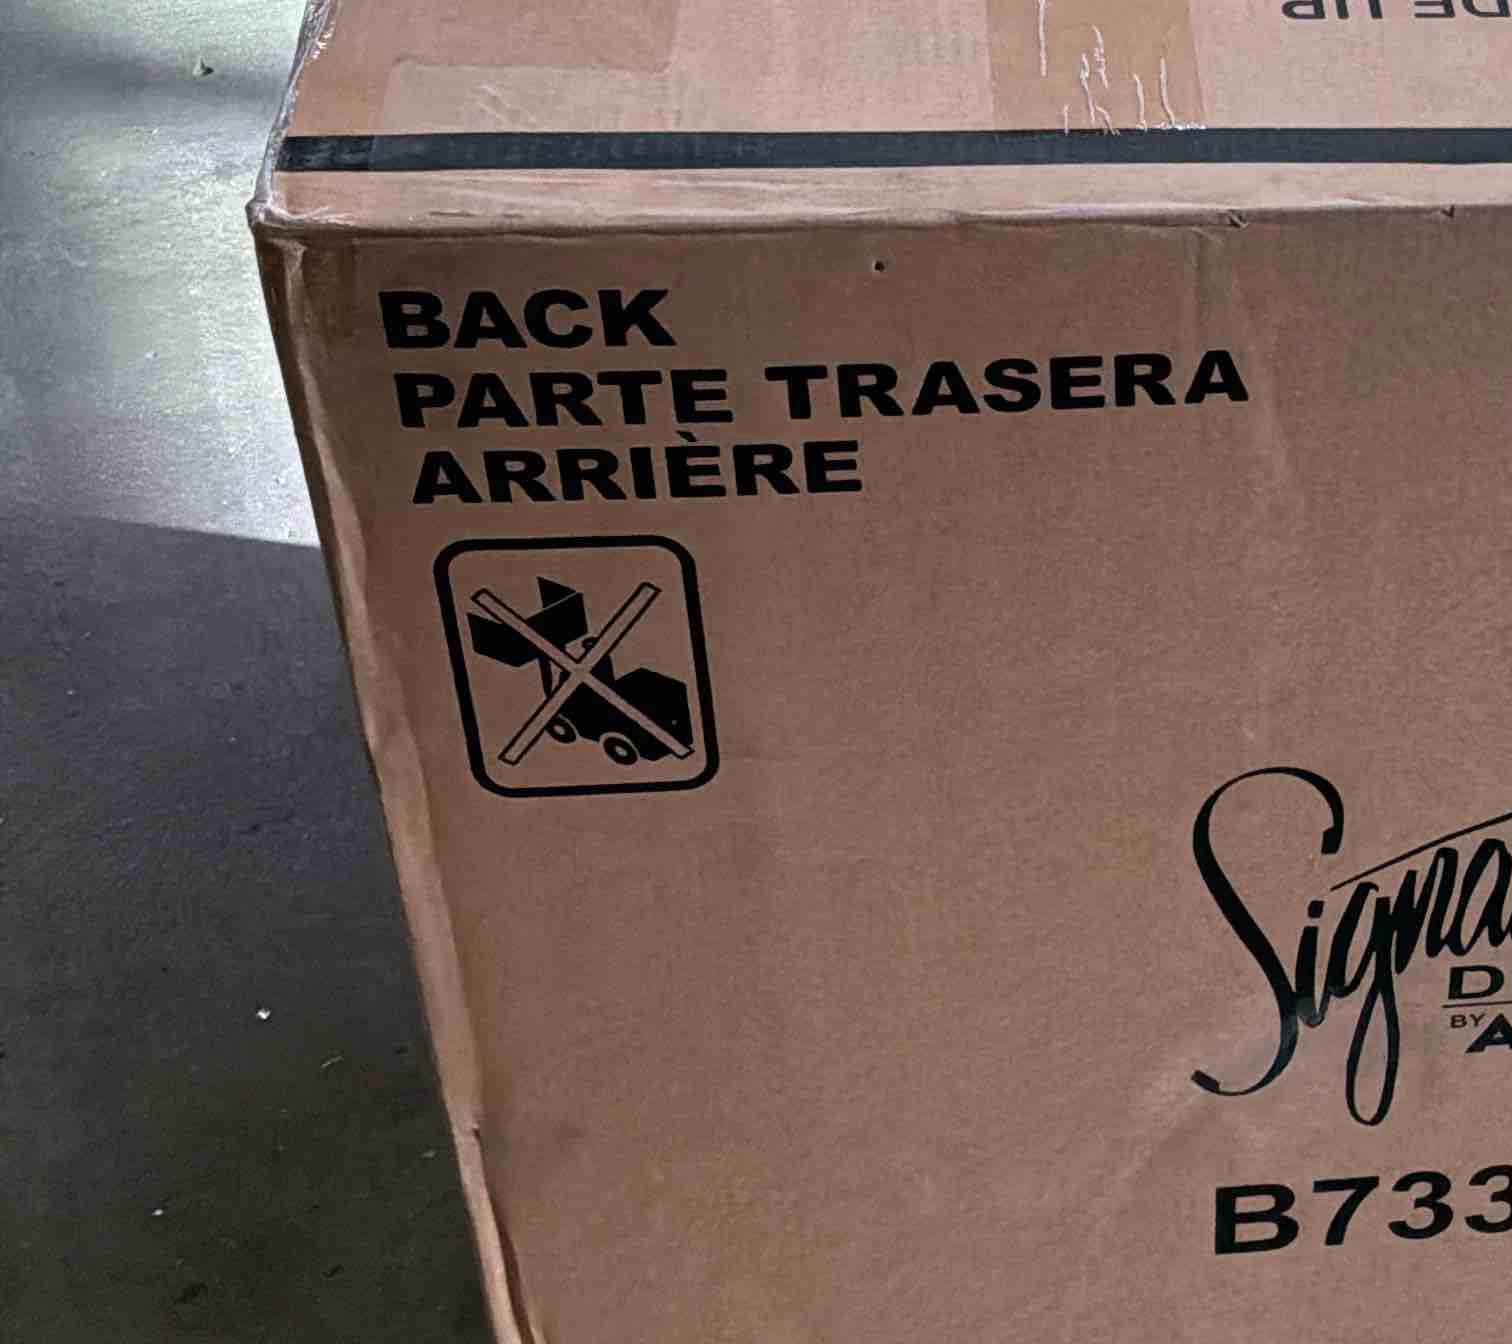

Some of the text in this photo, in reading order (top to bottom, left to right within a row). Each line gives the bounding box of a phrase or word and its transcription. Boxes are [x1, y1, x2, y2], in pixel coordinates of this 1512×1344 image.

[378, 289, 676, 349] BACK
[393, 350, 1248, 428] PARTE TRASERA
[411, 431, 862, 504] ARRIÈRE
[1451, 1014, 1485, 1028] BY
